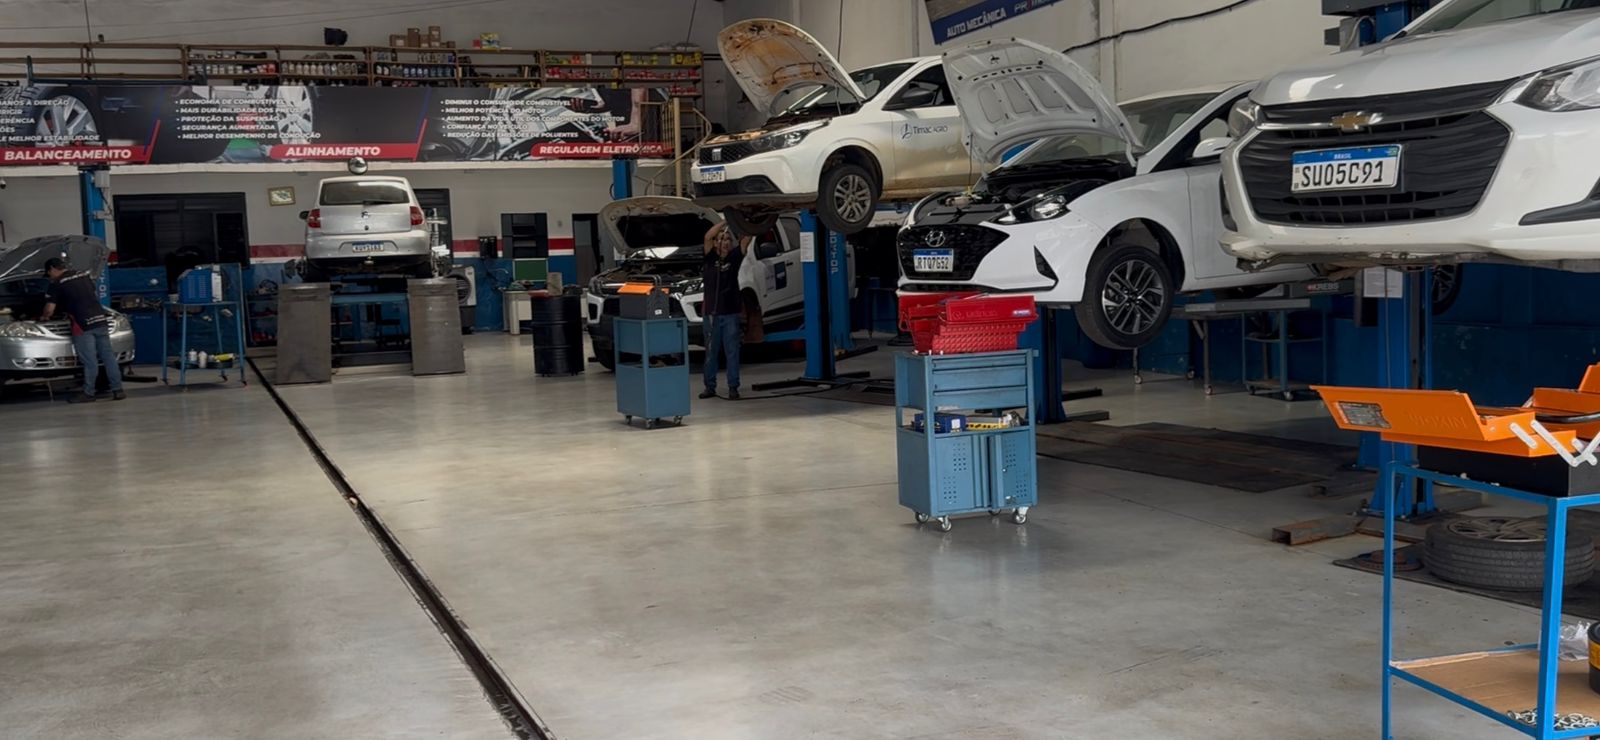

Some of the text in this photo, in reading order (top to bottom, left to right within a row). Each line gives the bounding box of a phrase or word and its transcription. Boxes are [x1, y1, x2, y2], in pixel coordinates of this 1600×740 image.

[947, 8, 1007, 38] AUTO MECÂNICA
[34, 97, 69, 106] DIREÇÃO
[525, 98, 571, 106] COMBUSTÍVEL
[181, 114, 221, 122] PROTEÇÃO
[285, 146, 381, 156] ALINHAMENTO
[540, 145, 600, 154] REGULAGEM
[4, 149, 132, 161] BALANCEAMENTO
